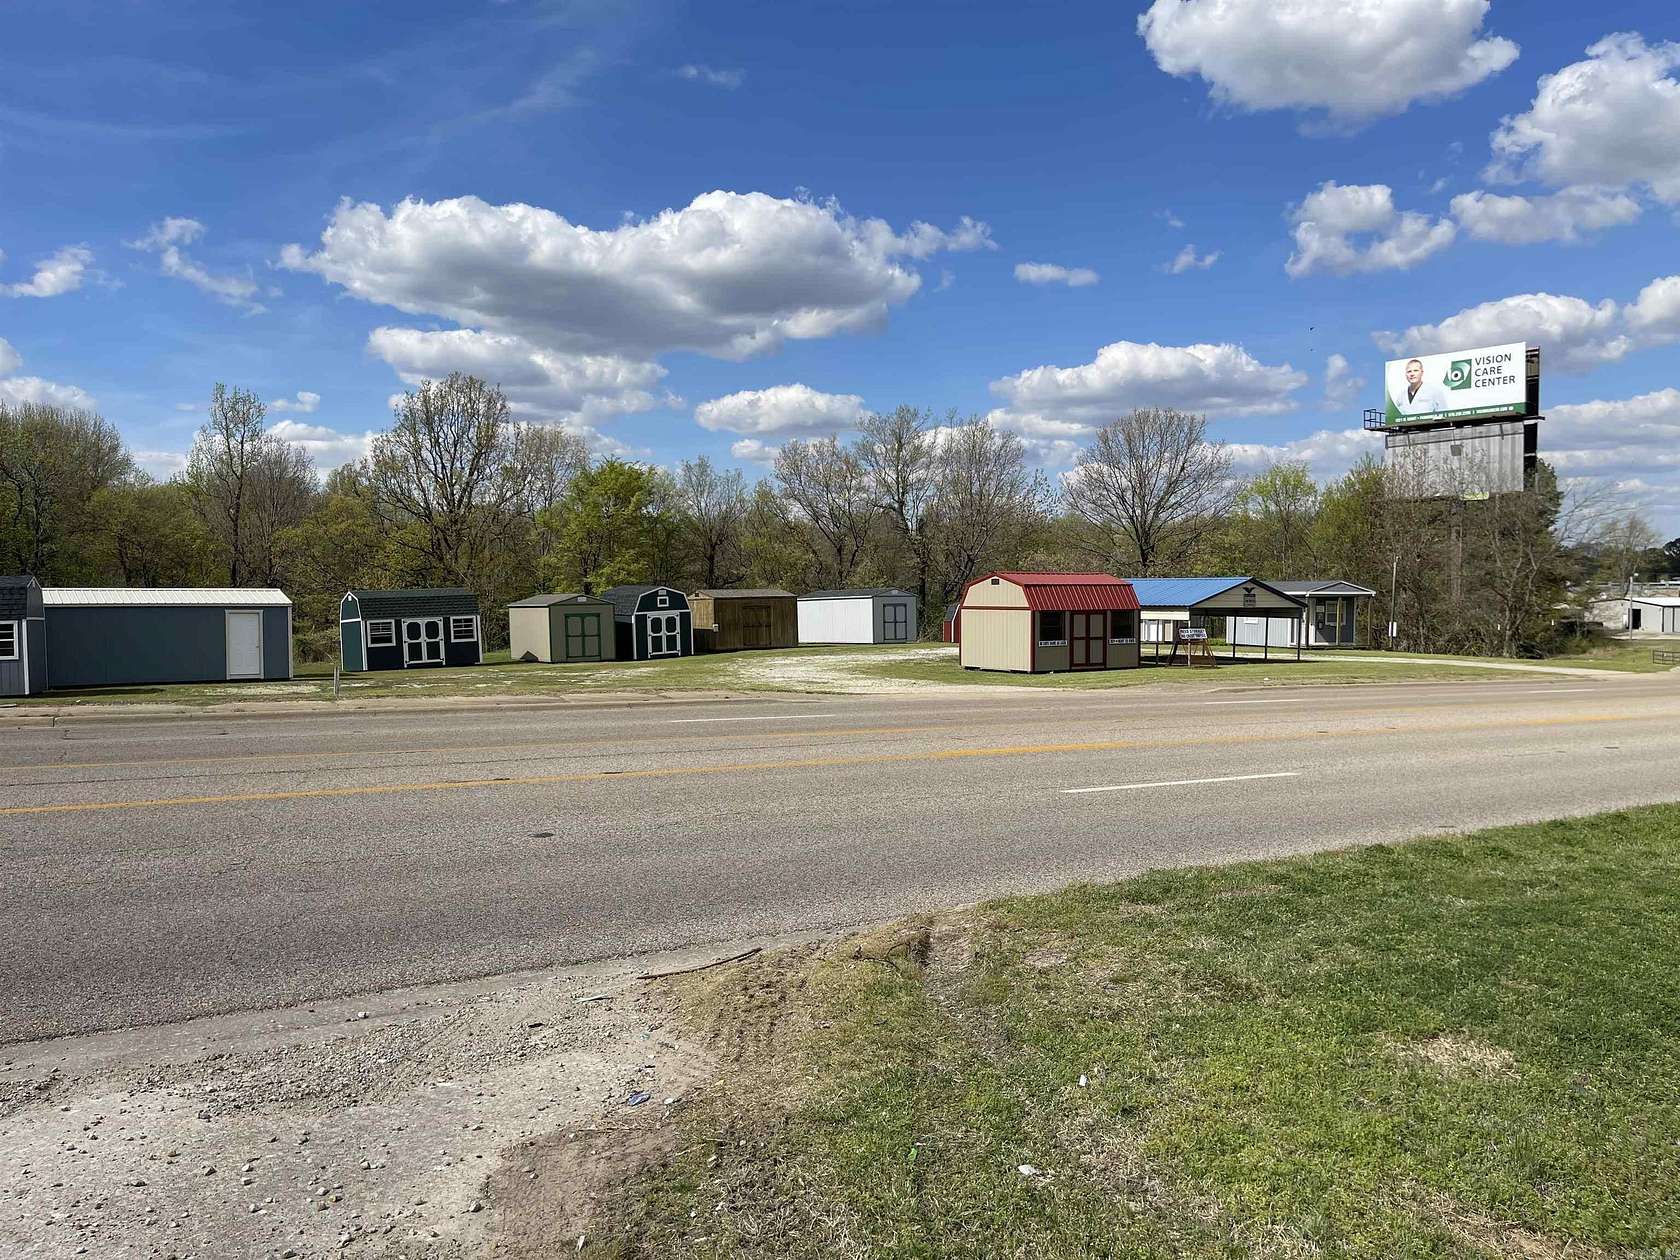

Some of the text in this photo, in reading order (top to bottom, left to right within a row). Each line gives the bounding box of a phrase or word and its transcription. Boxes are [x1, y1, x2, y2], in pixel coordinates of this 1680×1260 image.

[1474, 352, 1512, 366] VISION
[1474, 365, 1503, 377] CARE
[1474, 375, 1516, 388] CENTER
